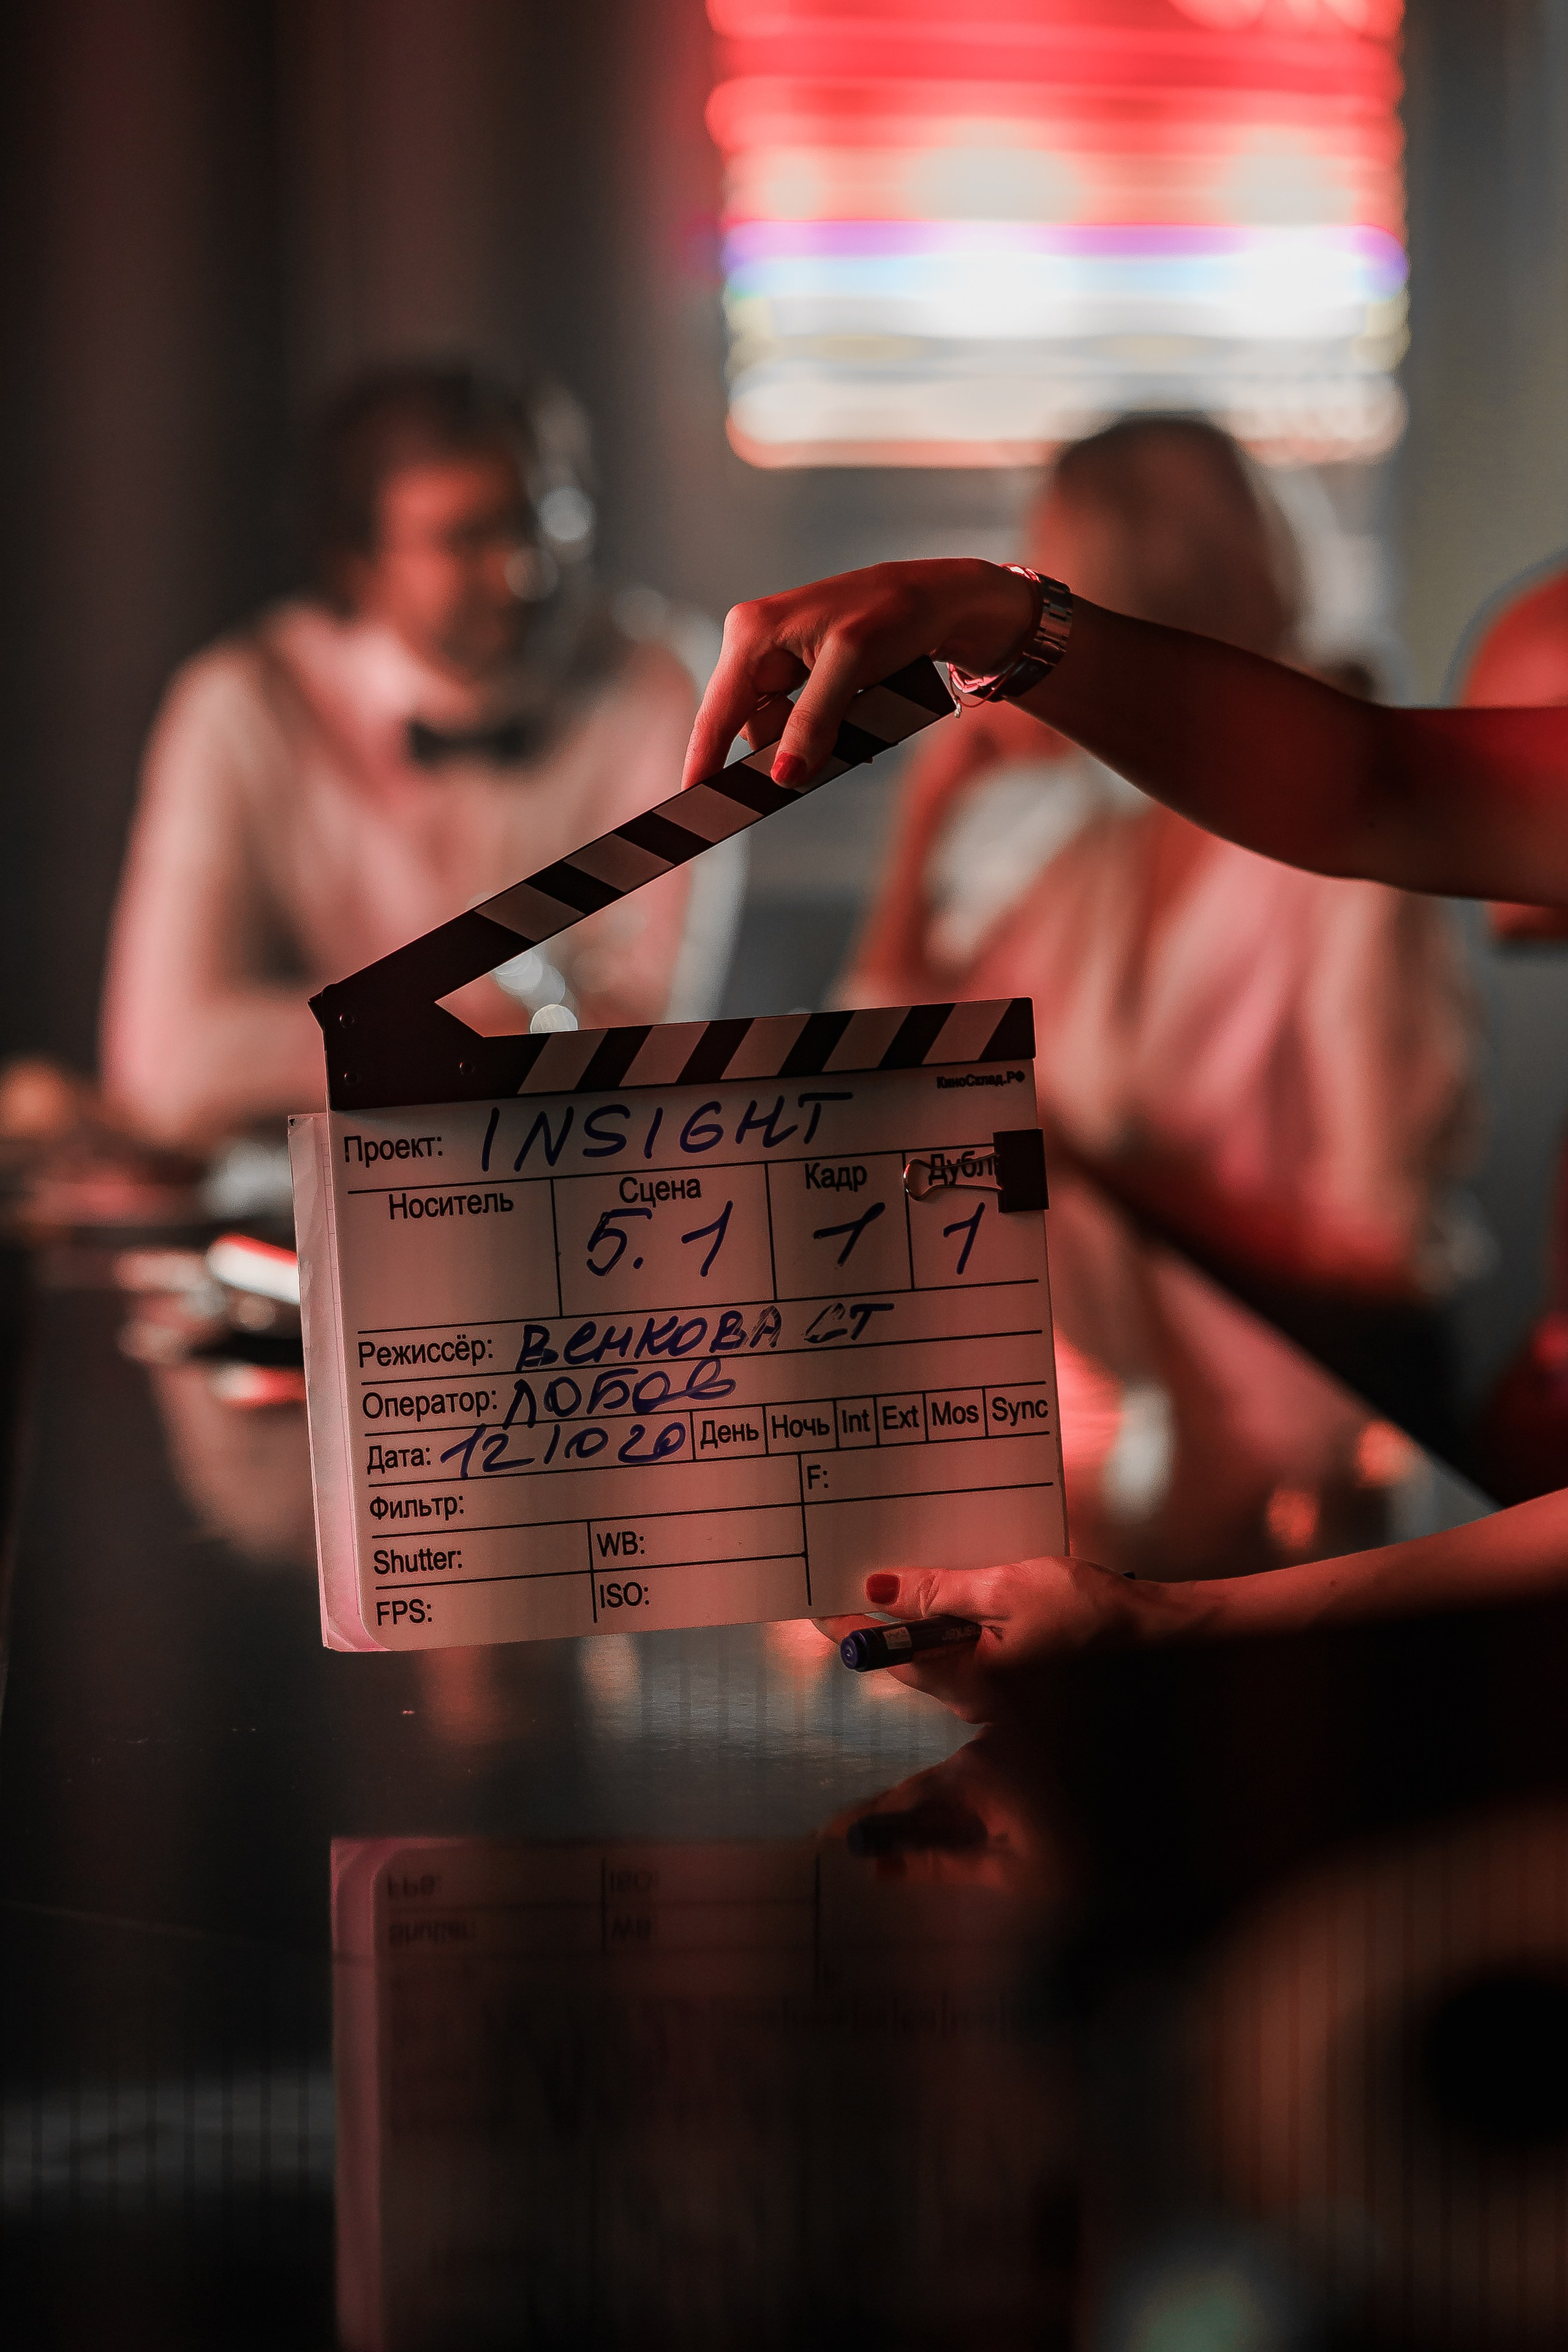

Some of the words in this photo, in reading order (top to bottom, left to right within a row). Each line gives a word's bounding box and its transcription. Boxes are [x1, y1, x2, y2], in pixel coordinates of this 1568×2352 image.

[481, 1091, 853, 1172] INSIGHT
[344, 1135, 443, 1168] Проект:
[805, 1163, 867, 1192] Кадр
[928, 1150, 1000, 1186] Дубл
[388, 1191, 514, 1220] Носитель
[619, 1176, 701, 1208] Сцена
[813, 1201, 886, 1267] 1
[943, 1200, 986, 1275] 1
[358, 1335, 494, 1368] Режиссёр:
[363, 1387, 497, 1422] Оператор:
[882, 1405, 920, 1430] Ext
[931, 1400, 980, 1427] Mos
[991, 1396, 1049, 1427] Sync
[700, 1419, 760, 1449] День
[771, 1414, 831, 1439] Ночь
[842, 1410, 870, 1433] Int
[368, 1444, 432, 1475] Дата:
[807, 1464, 829, 1489] F:
[369, 1494, 464, 1521] Фильтр:
[597, 1531, 646, 1558] WB:
[373, 1548, 463, 1575] Shutter:
[600, 1581, 650, 1609] ISO:
[375, 1599, 432, 1627] FPS:
